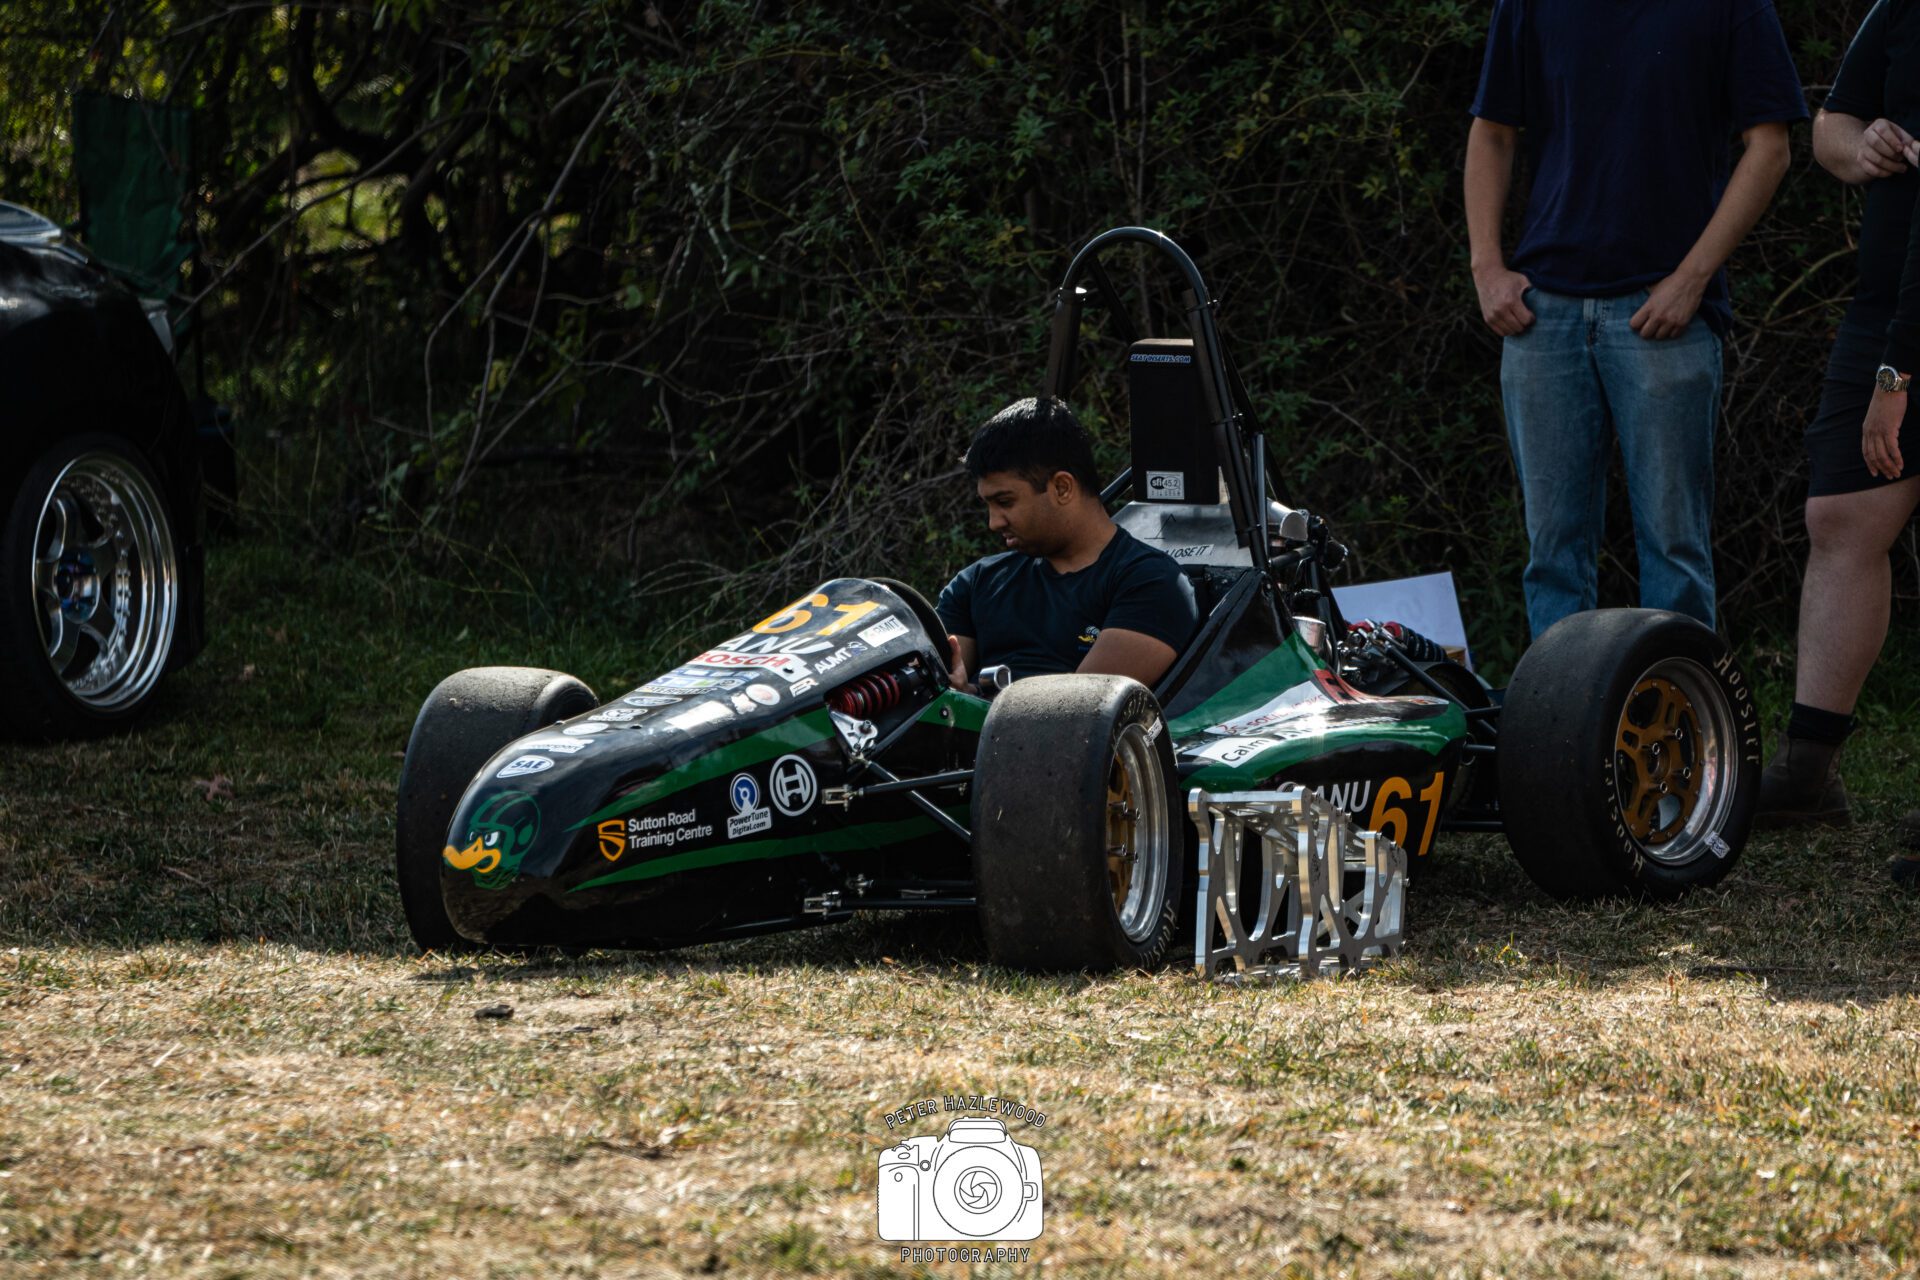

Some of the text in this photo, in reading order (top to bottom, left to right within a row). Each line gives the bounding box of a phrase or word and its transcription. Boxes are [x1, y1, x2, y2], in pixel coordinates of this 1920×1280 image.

[752, 593, 882, 636] 61
[695, 652, 791, 668] BOSCH
[814, 646, 852, 674] AUMT
[1221, 738, 1271, 762] Calm
[512, 760, 545, 769] SAE
[628, 808, 696, 833] Sutton Road
[729, 810, 769, 828] PowerTune
[1369, 771, 1445, 857] 61
[628, 824, 713, 849] Training Centre
